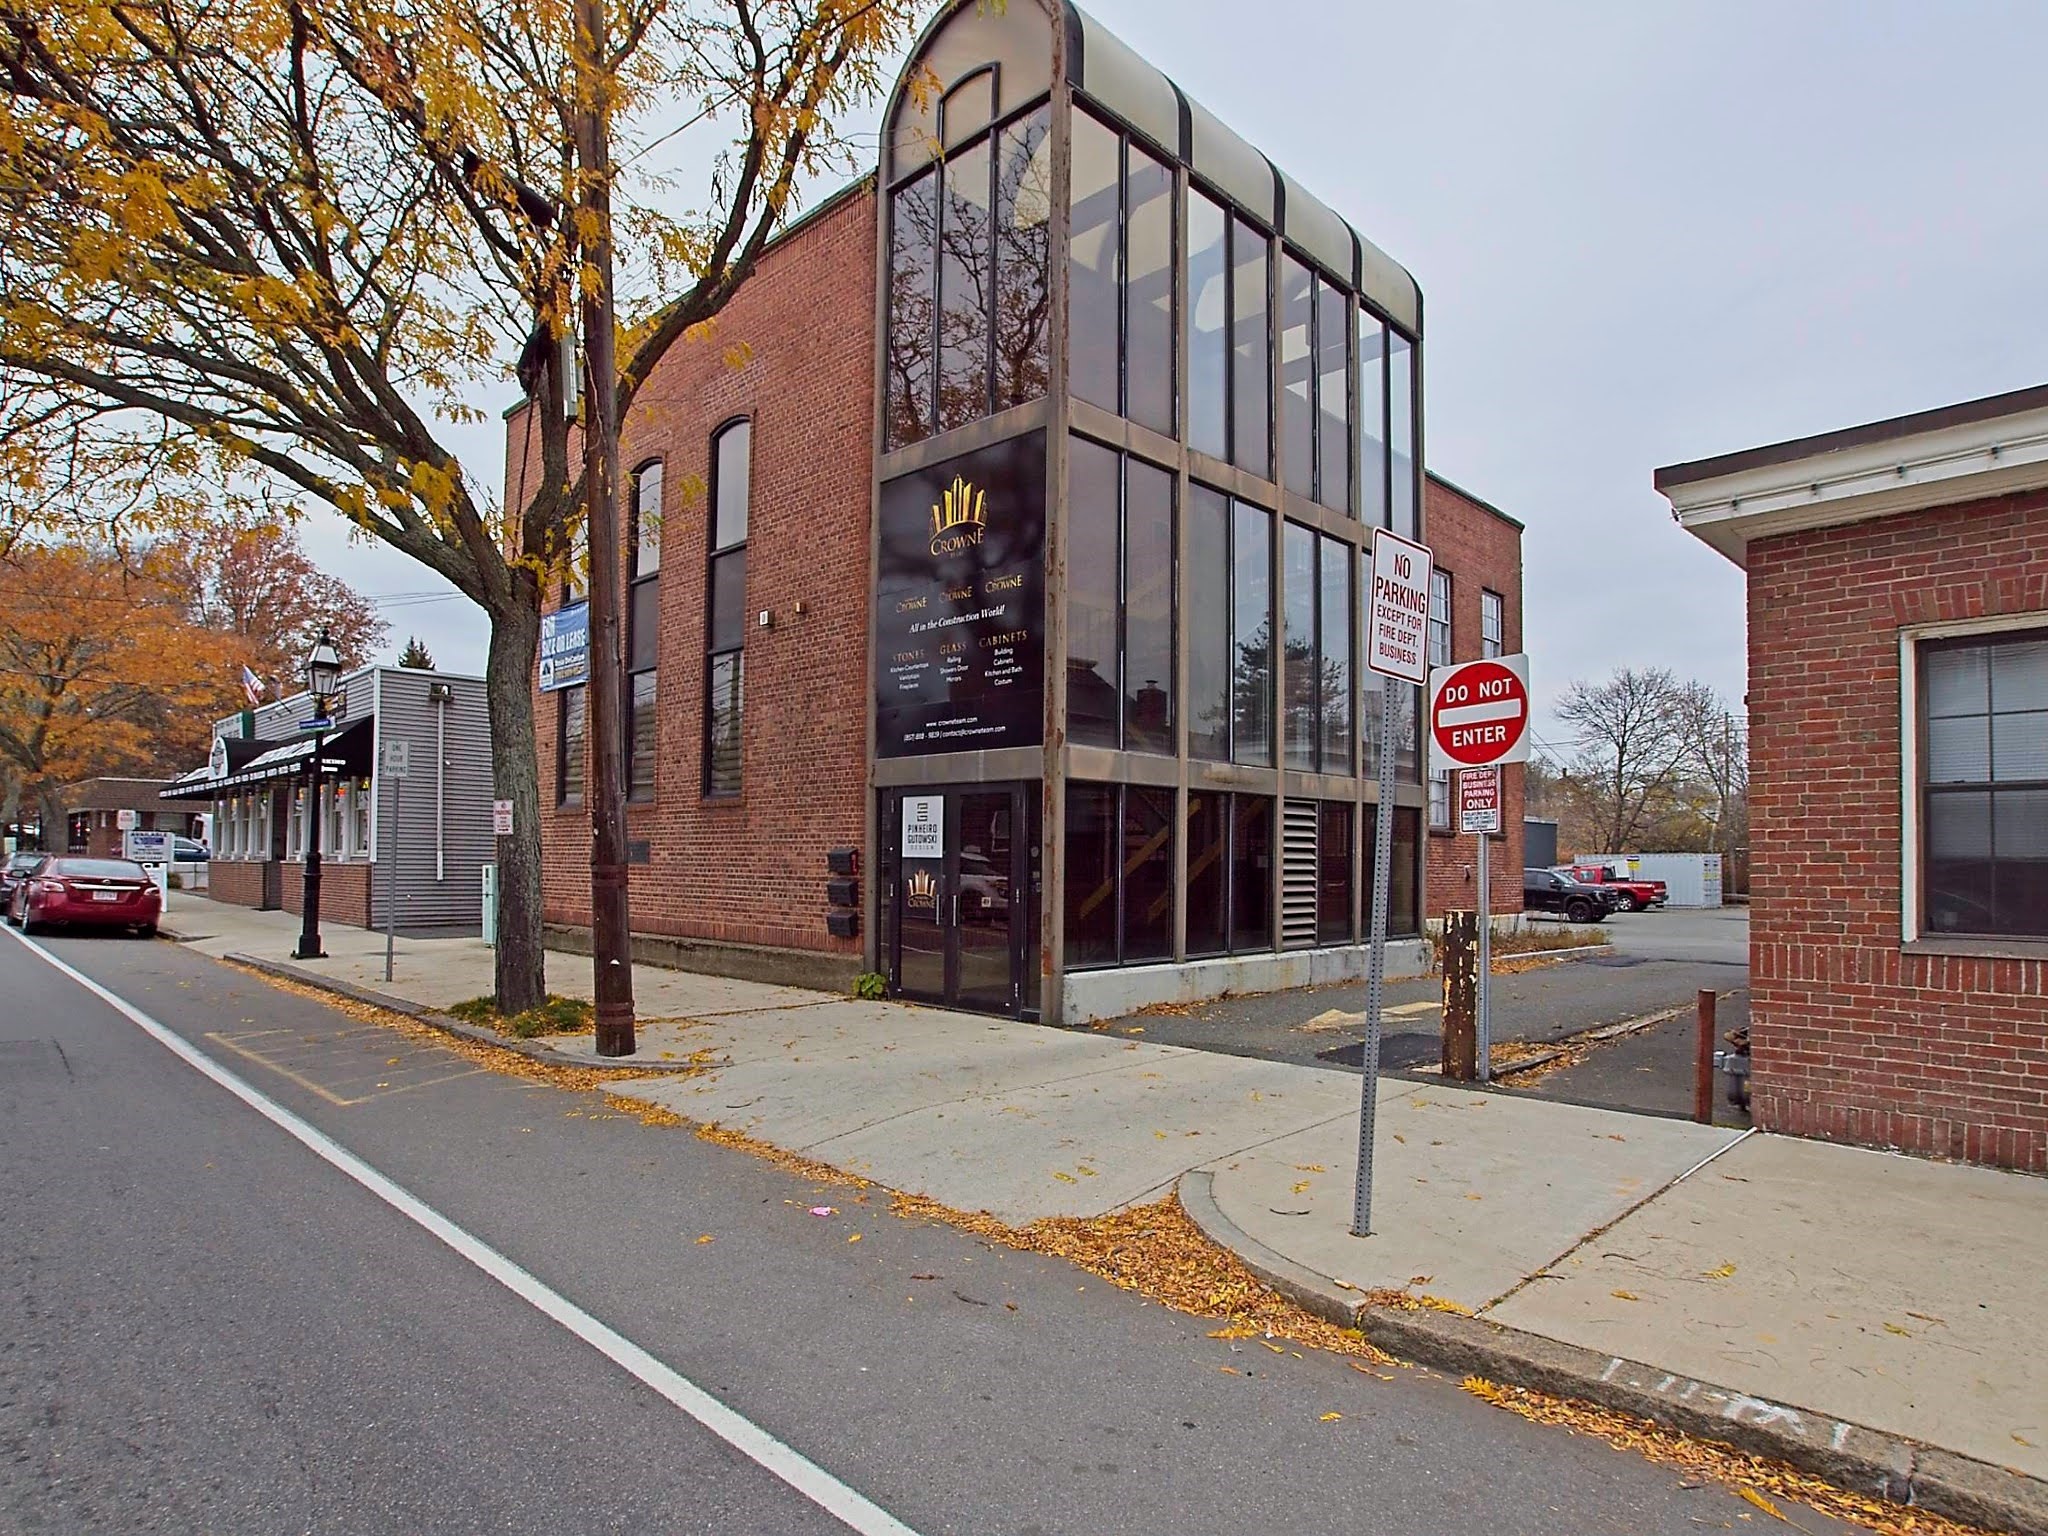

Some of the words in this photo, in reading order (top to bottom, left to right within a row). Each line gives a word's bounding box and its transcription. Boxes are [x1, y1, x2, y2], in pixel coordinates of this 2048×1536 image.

[931, 527, 984, 556] CROWNE
[1394, 554, 1411, 580] NO
[1375, 576, 1426, 614] PARKING
[909, 623, 920, 634] All
[927, 620, 938, 630] the
[938, 612, 980, 627] Construction
[981, 604, 1006, 619] World!
[1377, 604, 1406, 626] EXCEPT
[1407, 615, 1422, 631] FOR
[565, 627, 586, 651] LEASE
[979, 629, 1027, 648] CABINETS
[1378, 623, 1396, 641] FIRE
[1397, 629, 1419, 648] DEPT.
[940, 641, 967, 655] GLASS
[1379, 642, 1416, 665] BUSINESS
[984, 669, 1002, 677] Kitchen
[1002, 667, 1011, 675] and
[1012, 665, 1022, 673] Bath
[993, 657, 1014, 666] Cabinets
[1446, 685, 1468, 704] DO
[1479, 678, 1513, 699] NOT
[1452, 725, 1506, 748] ENTER
[1462, 772, 1478, 780] FIRE
[1463, 779, 1496, 789] BUSINESS
[1464, 788, 1495, 798] PARKING
[1466, 798, 1493, 809] ONLY
[908, 824, 937, 833] PINHEIRO
[908, 834, 937, 844] GUTOWSKI
